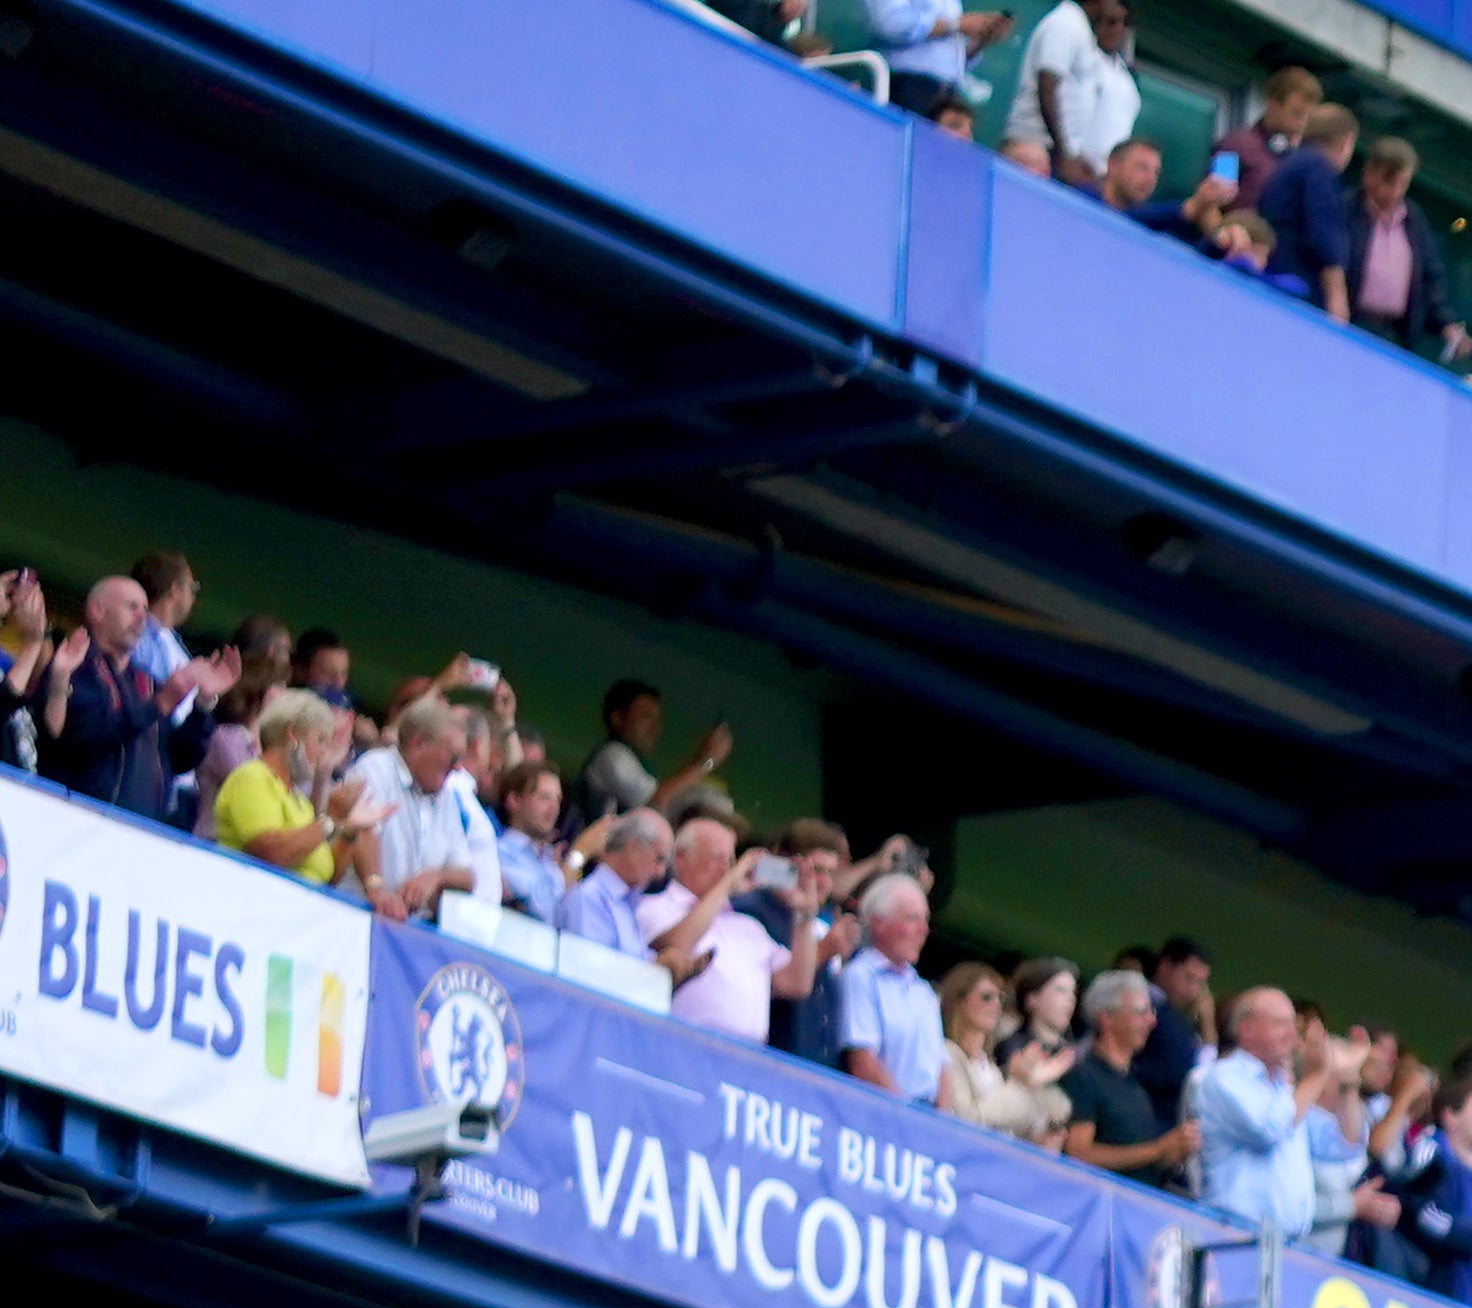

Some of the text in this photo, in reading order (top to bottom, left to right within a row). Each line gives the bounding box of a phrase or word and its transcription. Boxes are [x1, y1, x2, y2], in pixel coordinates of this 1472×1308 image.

[38, 876, 246, 1060] BLUES
[719, 1081, 958, 1219] TRUE BLUES
